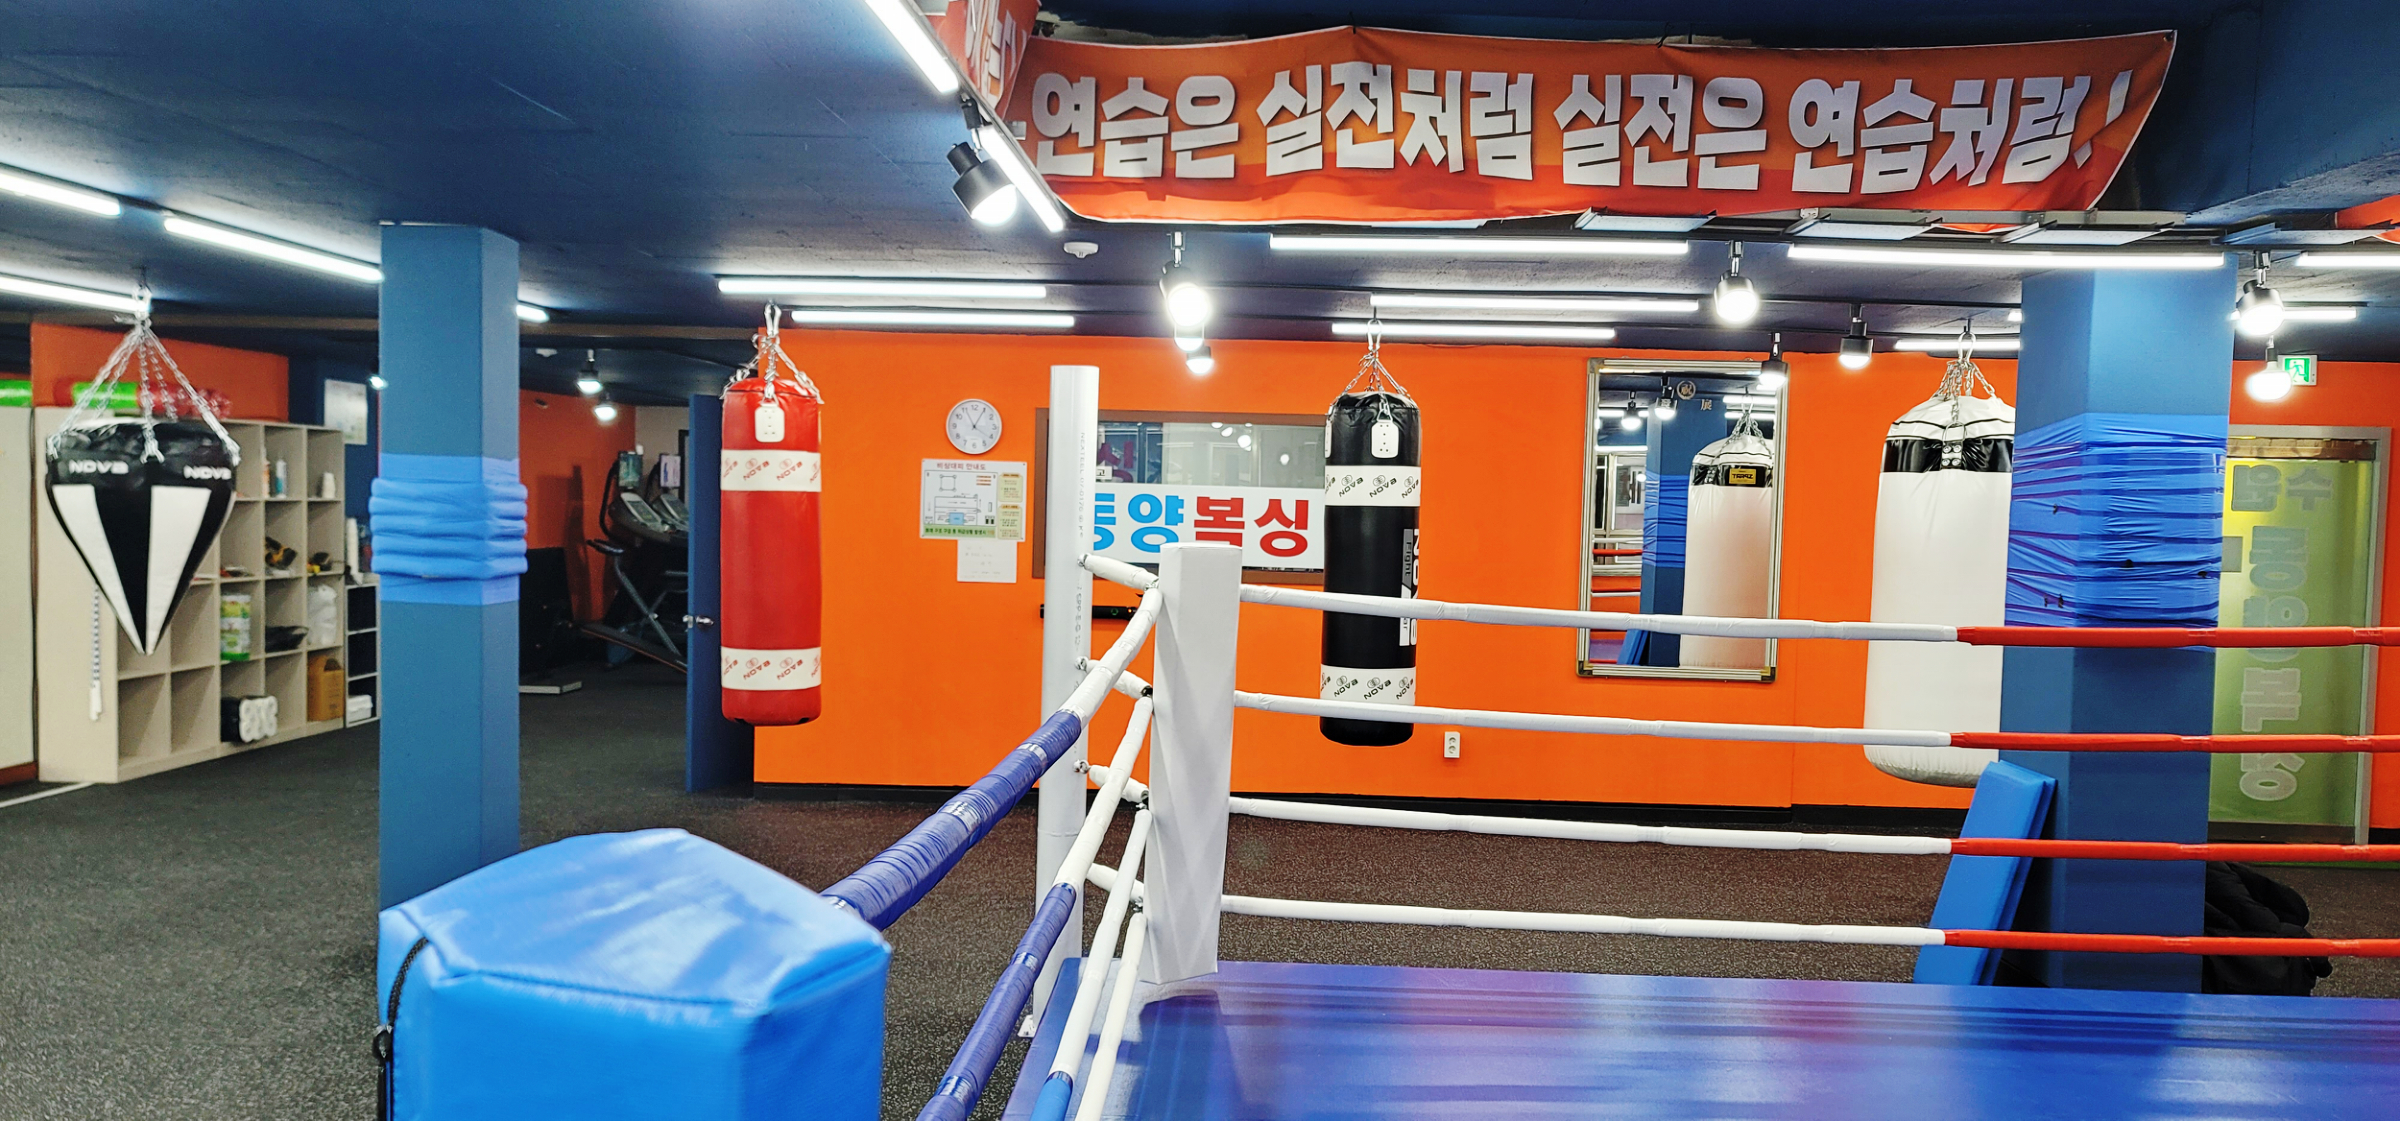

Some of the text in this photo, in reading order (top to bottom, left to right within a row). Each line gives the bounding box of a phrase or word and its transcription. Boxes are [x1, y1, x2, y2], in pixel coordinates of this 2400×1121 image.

[1032, 60, 2134, 195] 연습은 실전처럼 실전은 연습처럼!
[937, 462, 986, 471] 비상대피 안내도
[1404, 541, 1412, 576] Fight
